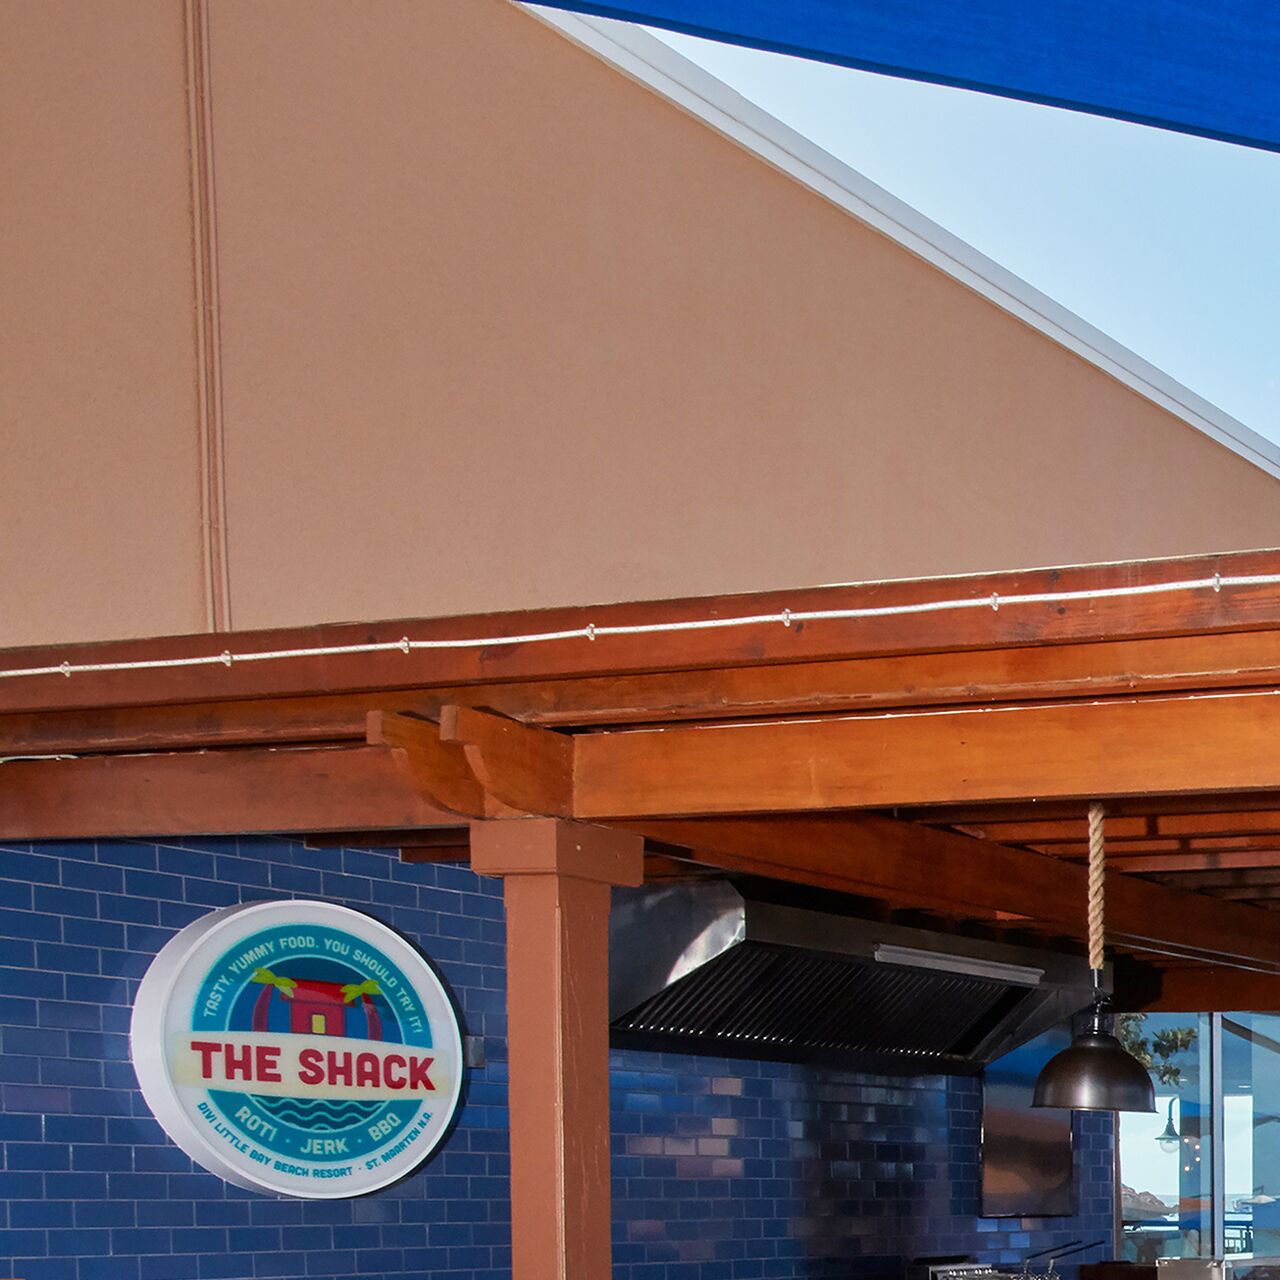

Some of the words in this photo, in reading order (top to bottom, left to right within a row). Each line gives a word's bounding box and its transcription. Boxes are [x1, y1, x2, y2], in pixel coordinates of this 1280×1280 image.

[204, 975, 234, 1017] TASTY,
[228, 940, 275, 974] YUMMY
[279, 936, 319, 950] FOOD.
[324, 938, 350, 955] YOU
[352, 949, 397, 988] SHOULD
[396, 988, 416, 1012] TRY
[409, 1016, 423, 1033] IT!
[191, 1040, 282, 1083] THE
[298, 1049, 436, 1091] SHACK
[197, 1102, 217, 1123] DIVI
[214, 1123, 250, 1154] LITTLE
[249, 1149, 271, 1166] BAY
[273, 1161, 310, 1177] BEACH
[313, 1167, 352, 1178] RESORT
[365, 1158, 381, 1170] ST.
[381, 1127, 420, 1163] MAARTEN
[234, 1106, 278, 1142] ROTI
[300, 1138, 350, 1156] JERK
[368, 1112, 402, 1142] BBQ
